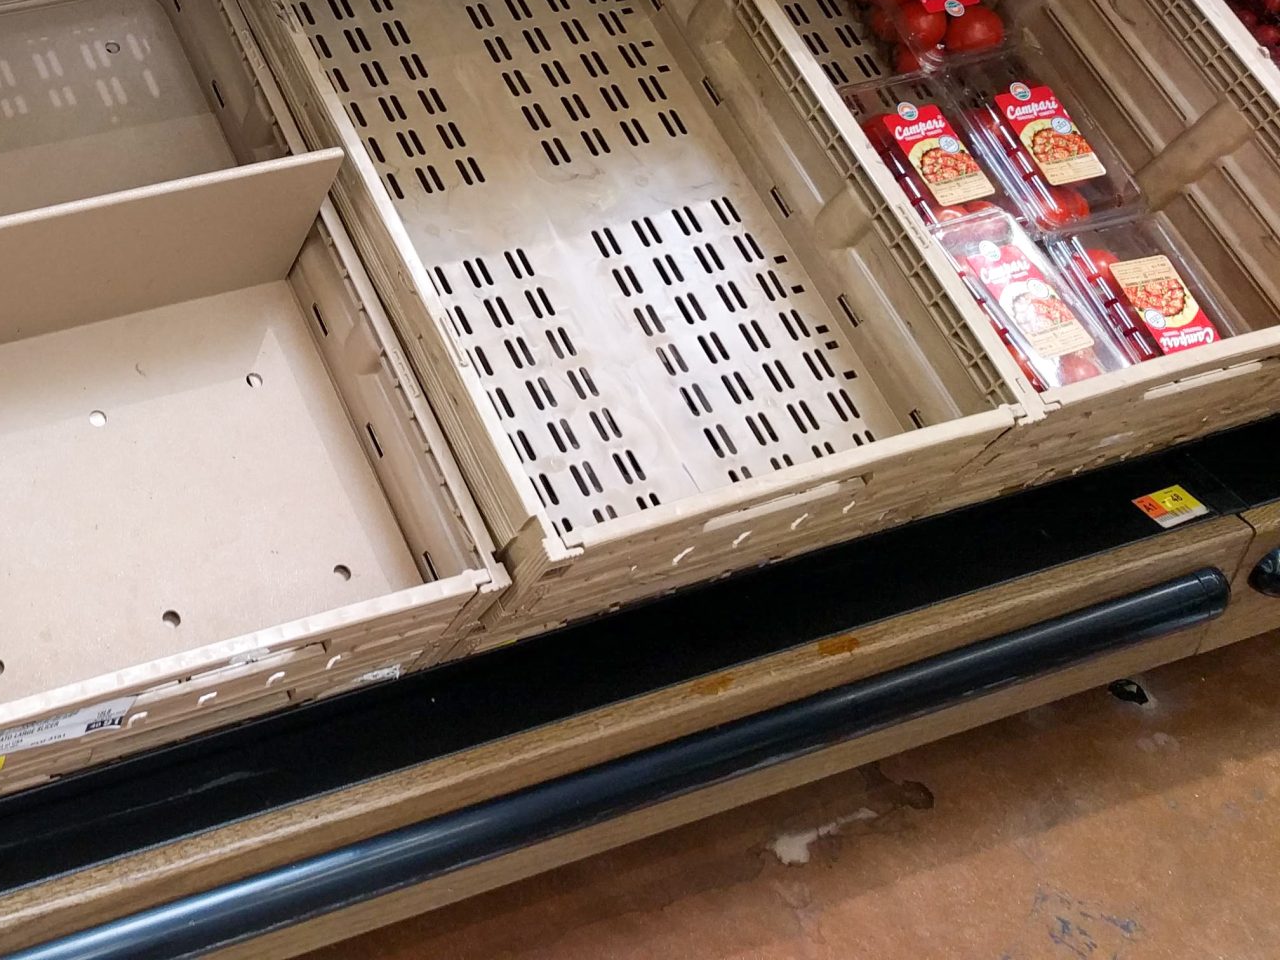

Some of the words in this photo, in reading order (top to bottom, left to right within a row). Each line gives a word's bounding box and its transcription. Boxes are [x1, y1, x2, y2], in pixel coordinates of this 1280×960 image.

[1006, 98, 1059, 121] Campari
[894, 115, 946, 141] Campari
[980, 256, 1031, 284] Campari
[1160, 326, 1215, 352] Campari
